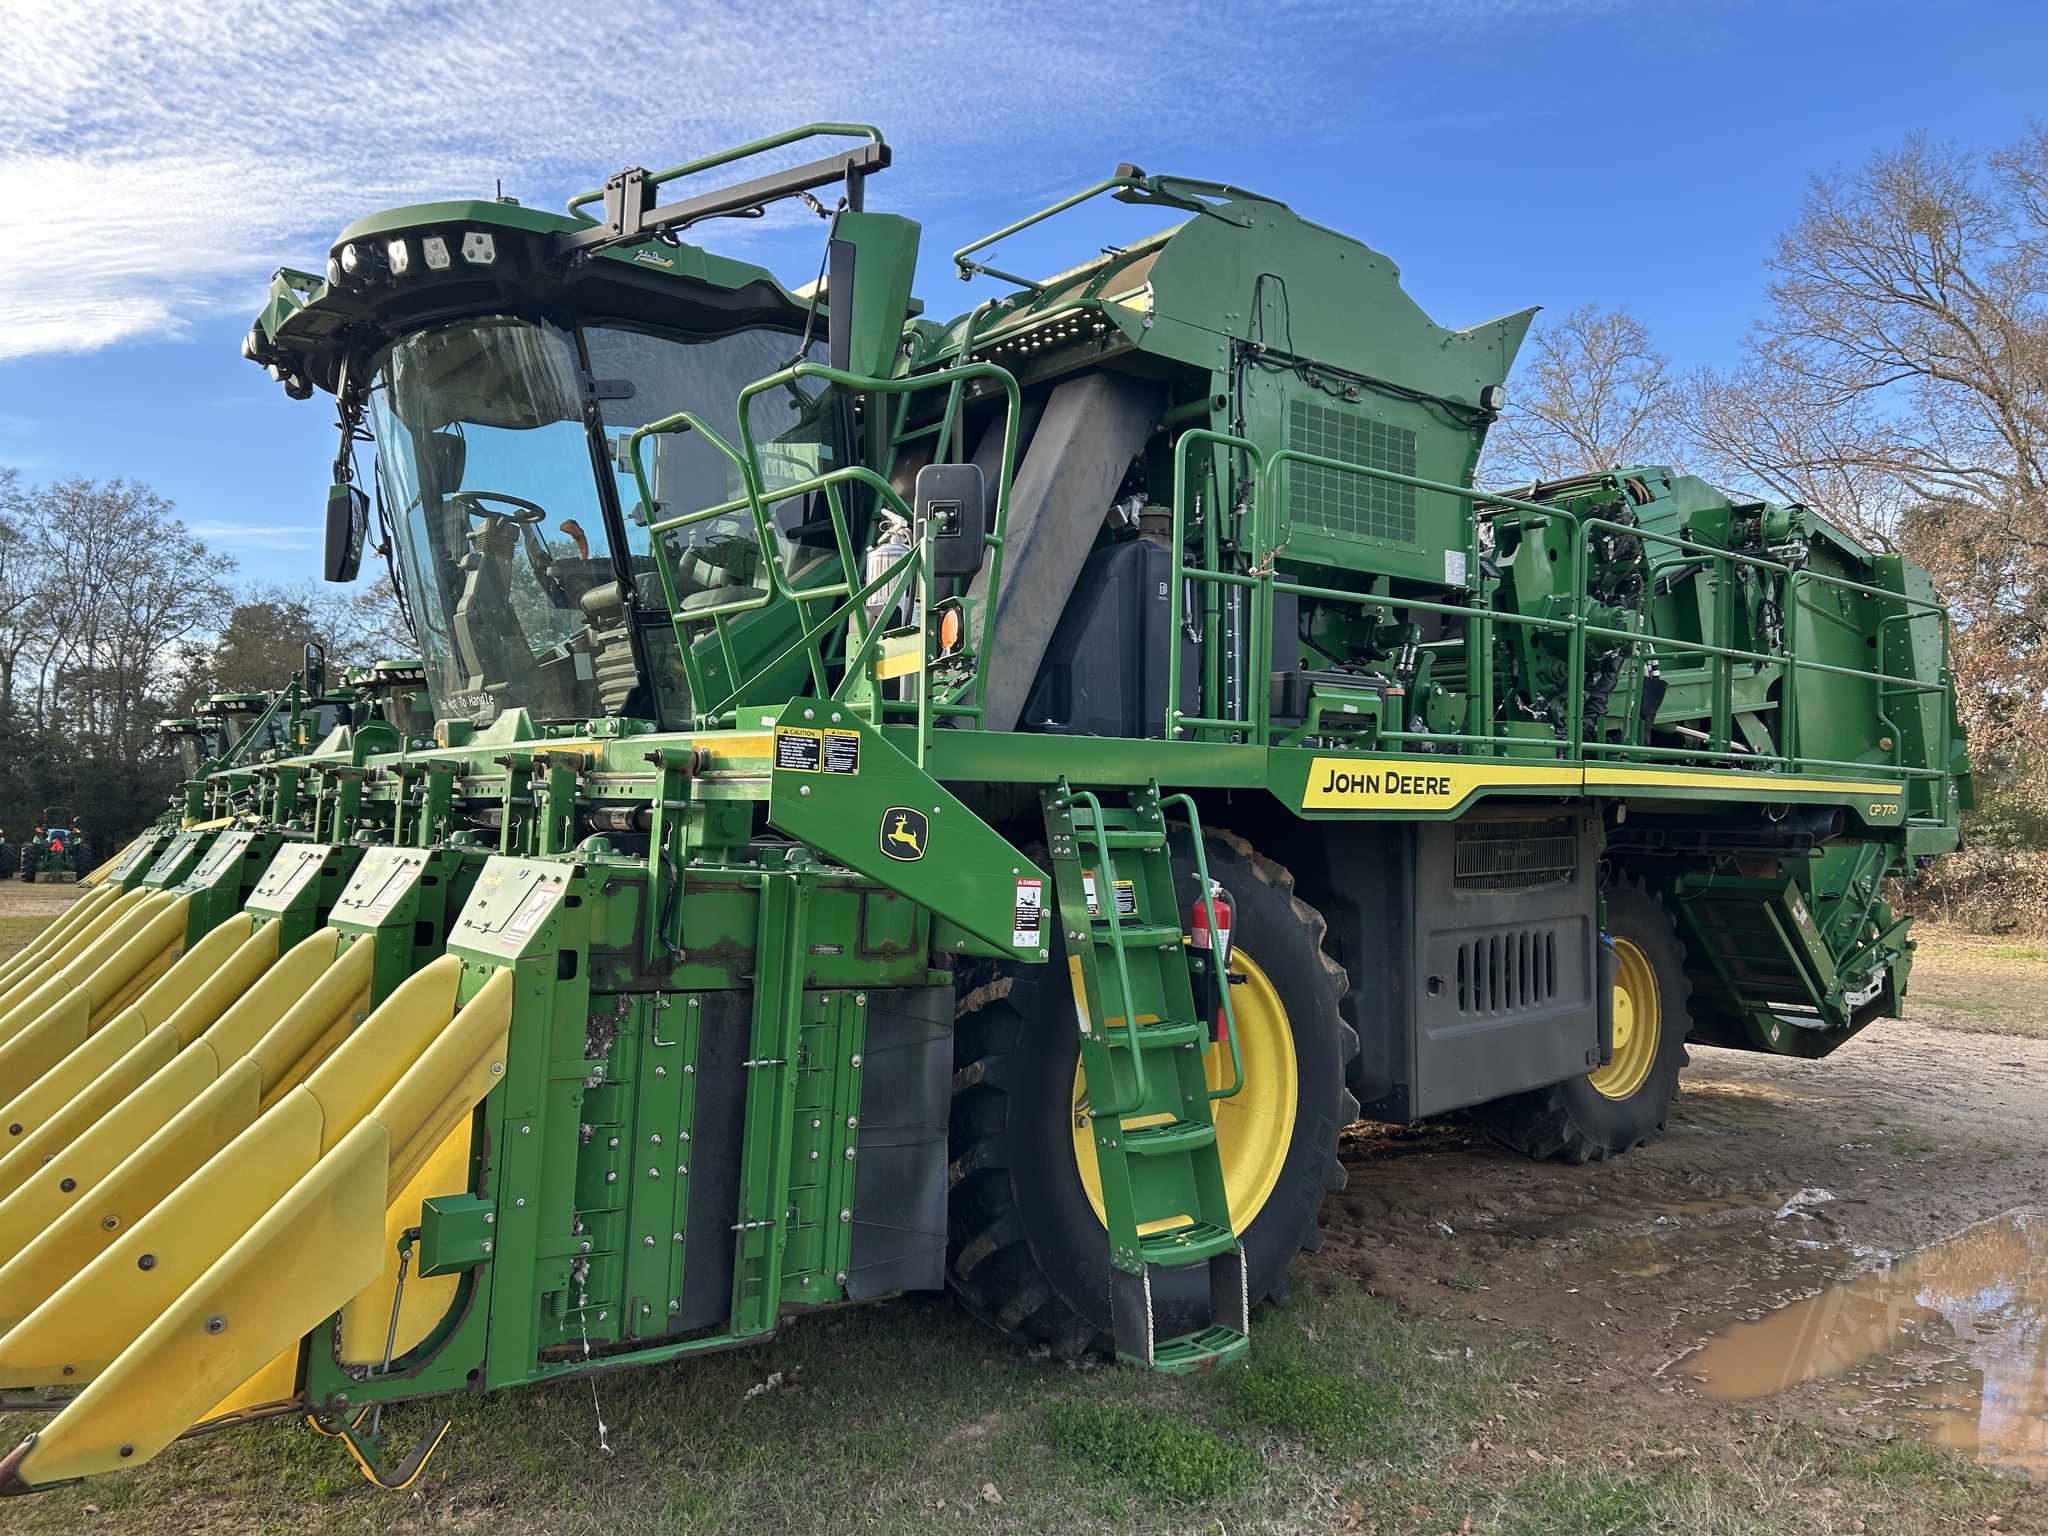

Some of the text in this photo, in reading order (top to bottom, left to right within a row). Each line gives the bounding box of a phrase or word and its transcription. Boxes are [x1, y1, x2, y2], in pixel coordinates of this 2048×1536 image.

[458, 697, 466, 707] To
[468, 692, 494, 706] Handle
[790, 729, 815, 737] CAUTION
[1323, 770, 1451, 795] JOHN DEERE
[1869, 803, 1898, 817] CP 770
